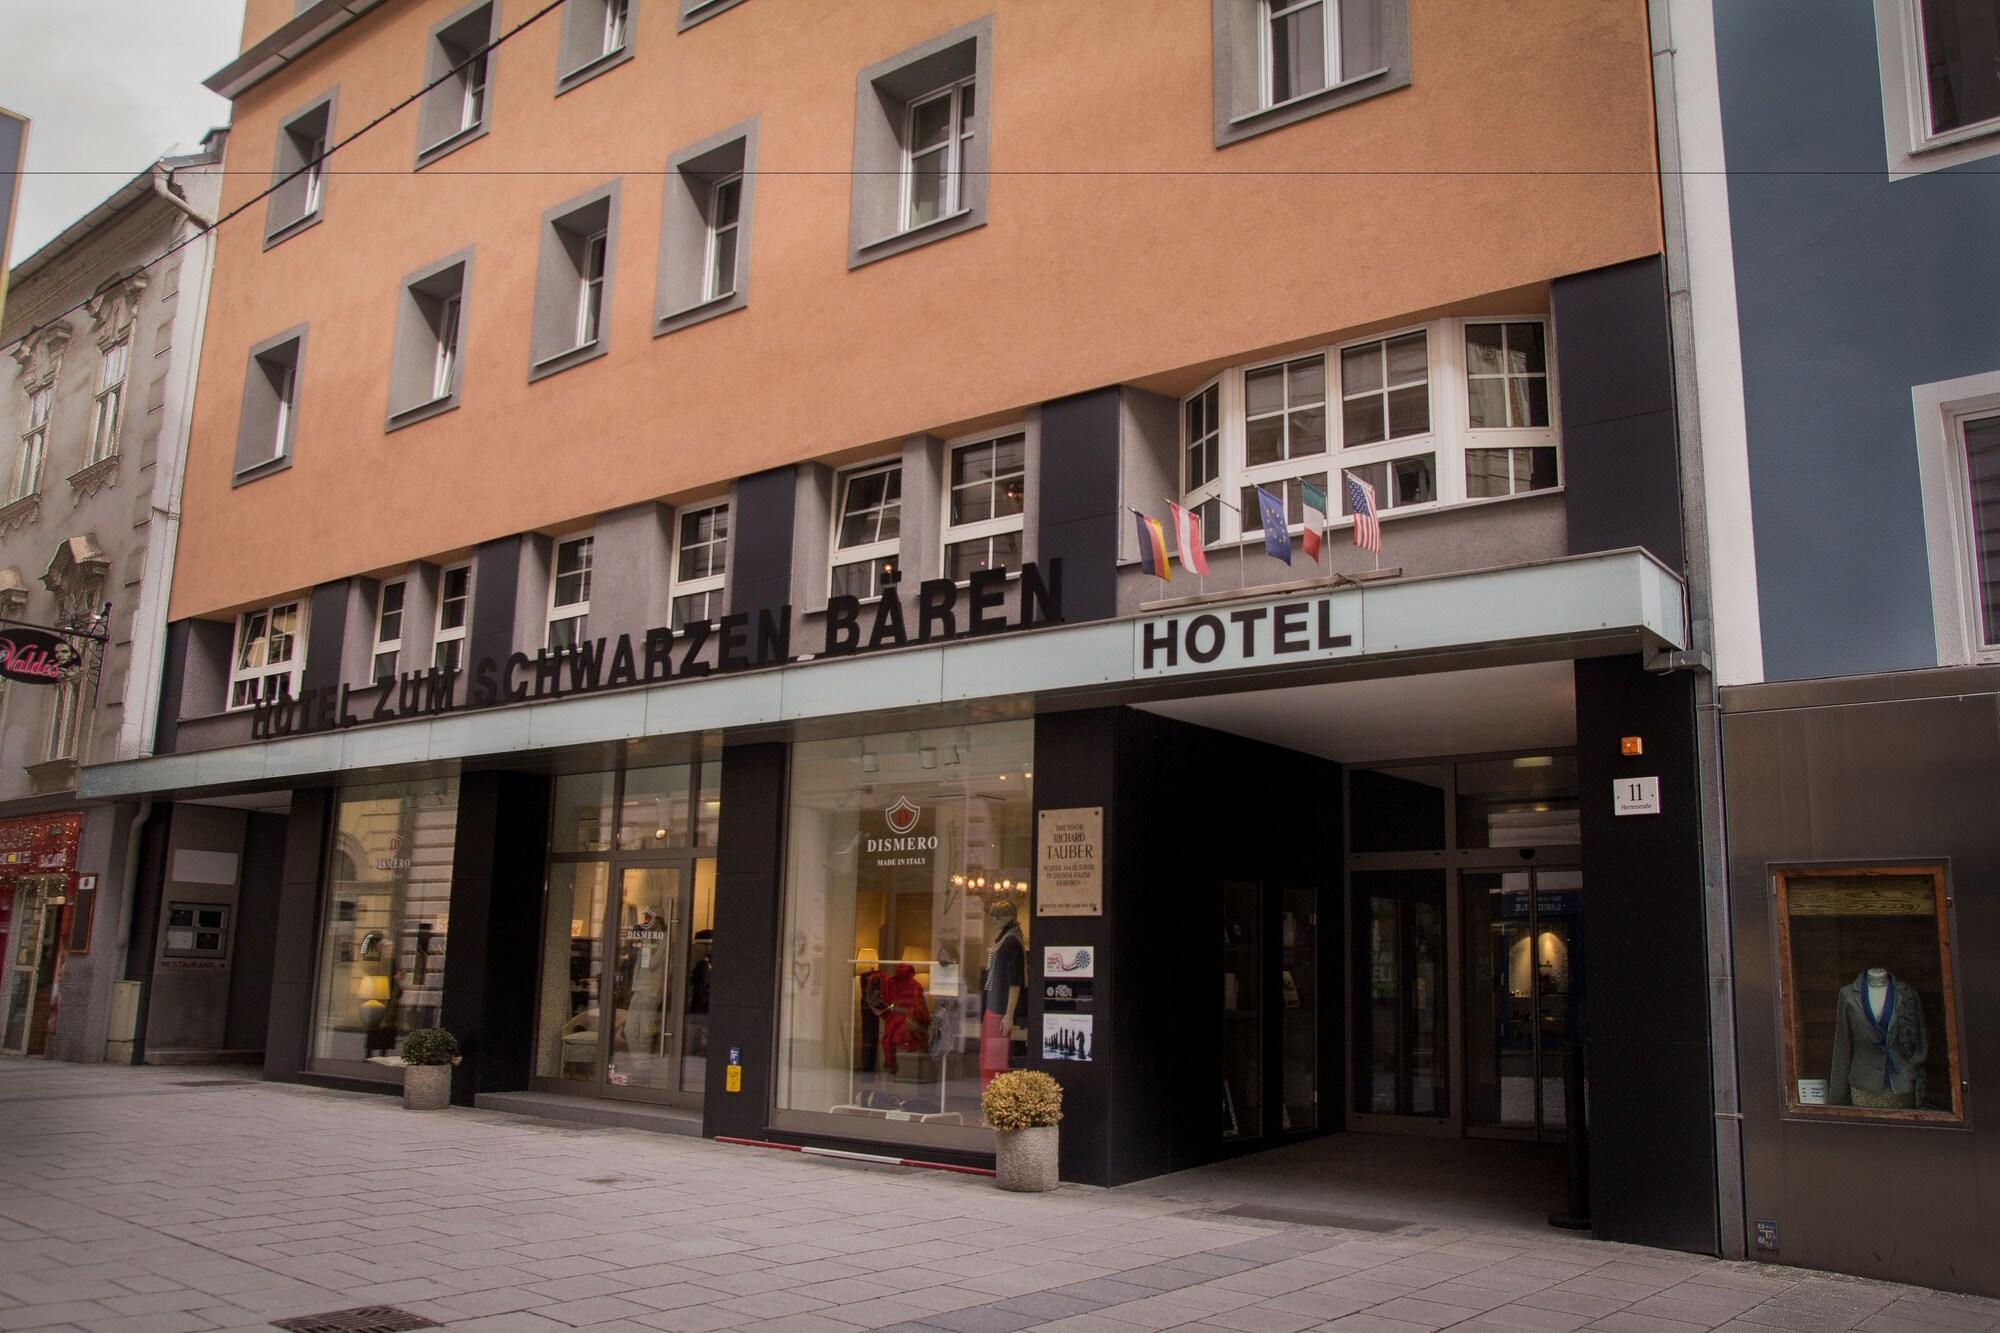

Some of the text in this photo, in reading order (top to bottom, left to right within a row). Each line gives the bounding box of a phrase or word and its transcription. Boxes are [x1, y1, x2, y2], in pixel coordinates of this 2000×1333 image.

[1143, 599, 1352, 670] HOTEL
[252, 558, 1063, 740] HOTEL ZUM SCHWARZEN BÄREN
[1628, 783, 1643, 801] 11
[867, 836, 938, 852] DISMERO
[1053, 832, 1086, 843] RICHARD
[1046, 844, 1093, 859] TAUBER
[907, 857, 926, 865] ITALY
[627, 930, 664, 940] DISMERO
